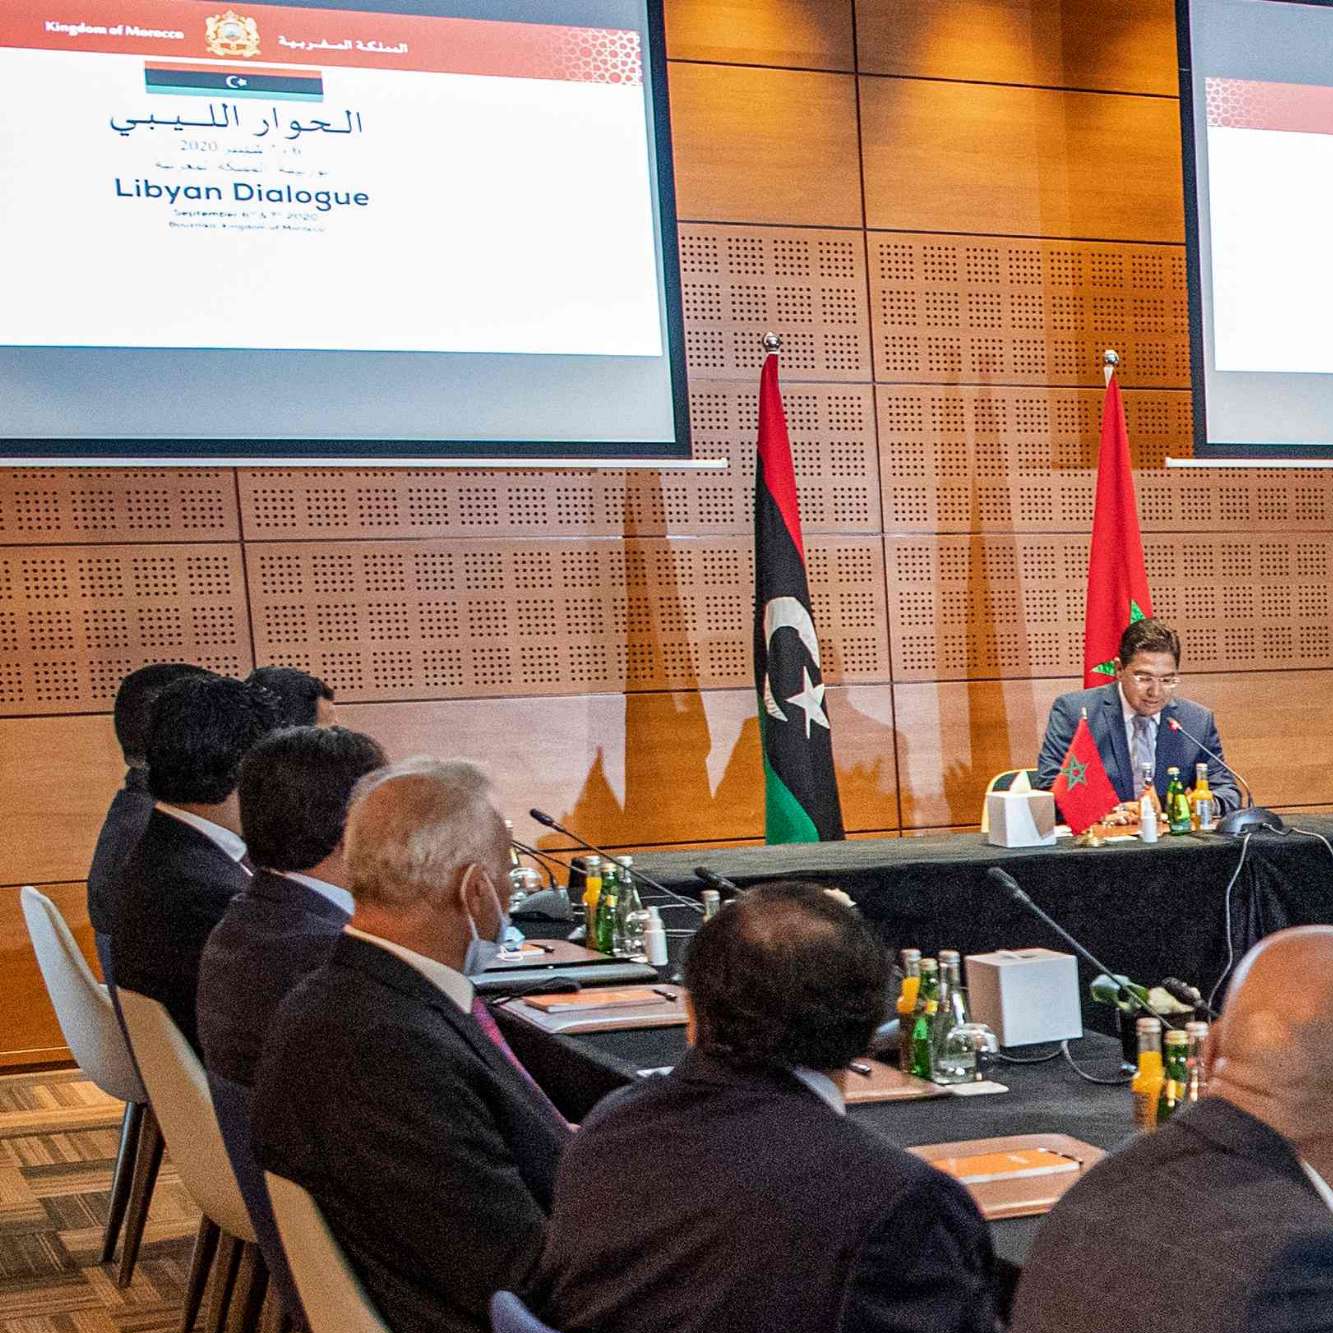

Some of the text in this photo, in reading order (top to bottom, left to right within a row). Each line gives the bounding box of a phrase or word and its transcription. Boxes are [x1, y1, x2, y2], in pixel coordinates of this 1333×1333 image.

[45, 21, 184, 39] Kingdom of Morocco
[278, 35, 408, 54] المملكة المغربية
[110, 103, 363, 140] الحوار الليبي
[114, 177, 369, 212] Libyan Dialogue
